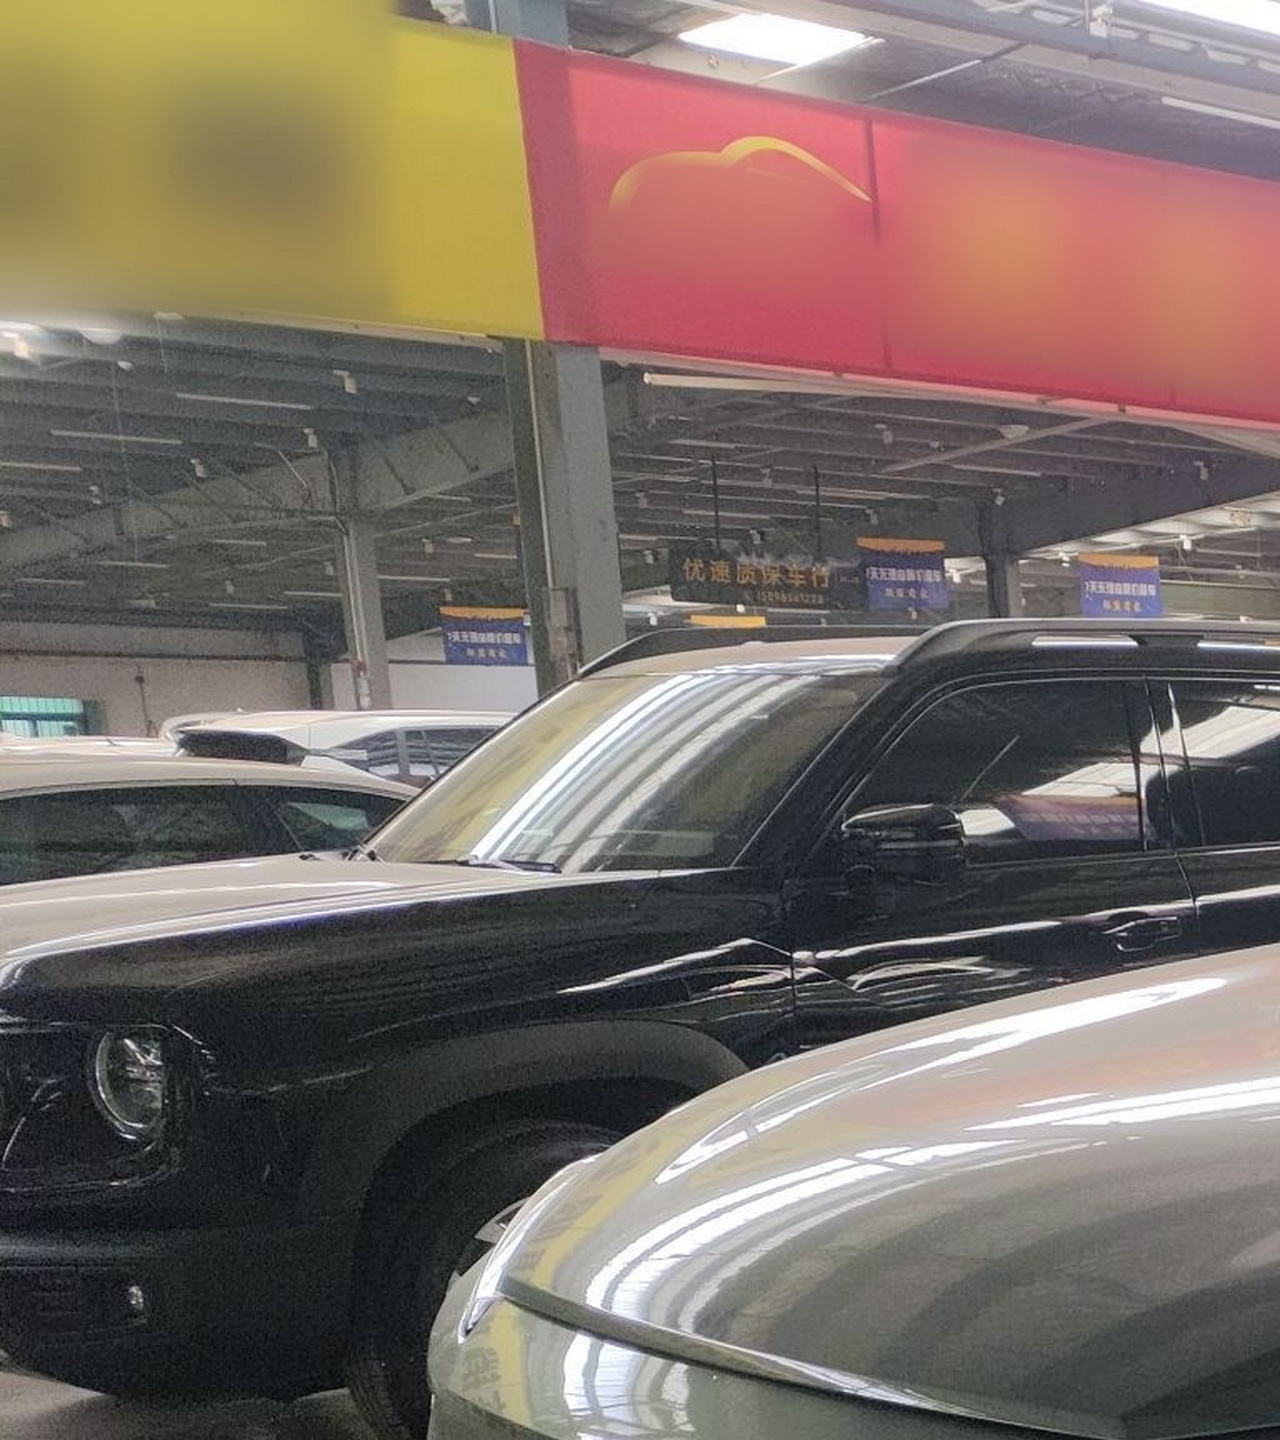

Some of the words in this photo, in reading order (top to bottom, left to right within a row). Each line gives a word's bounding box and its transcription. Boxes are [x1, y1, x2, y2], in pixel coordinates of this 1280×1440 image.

[683, 558, 830, 588] 优速质保车行
